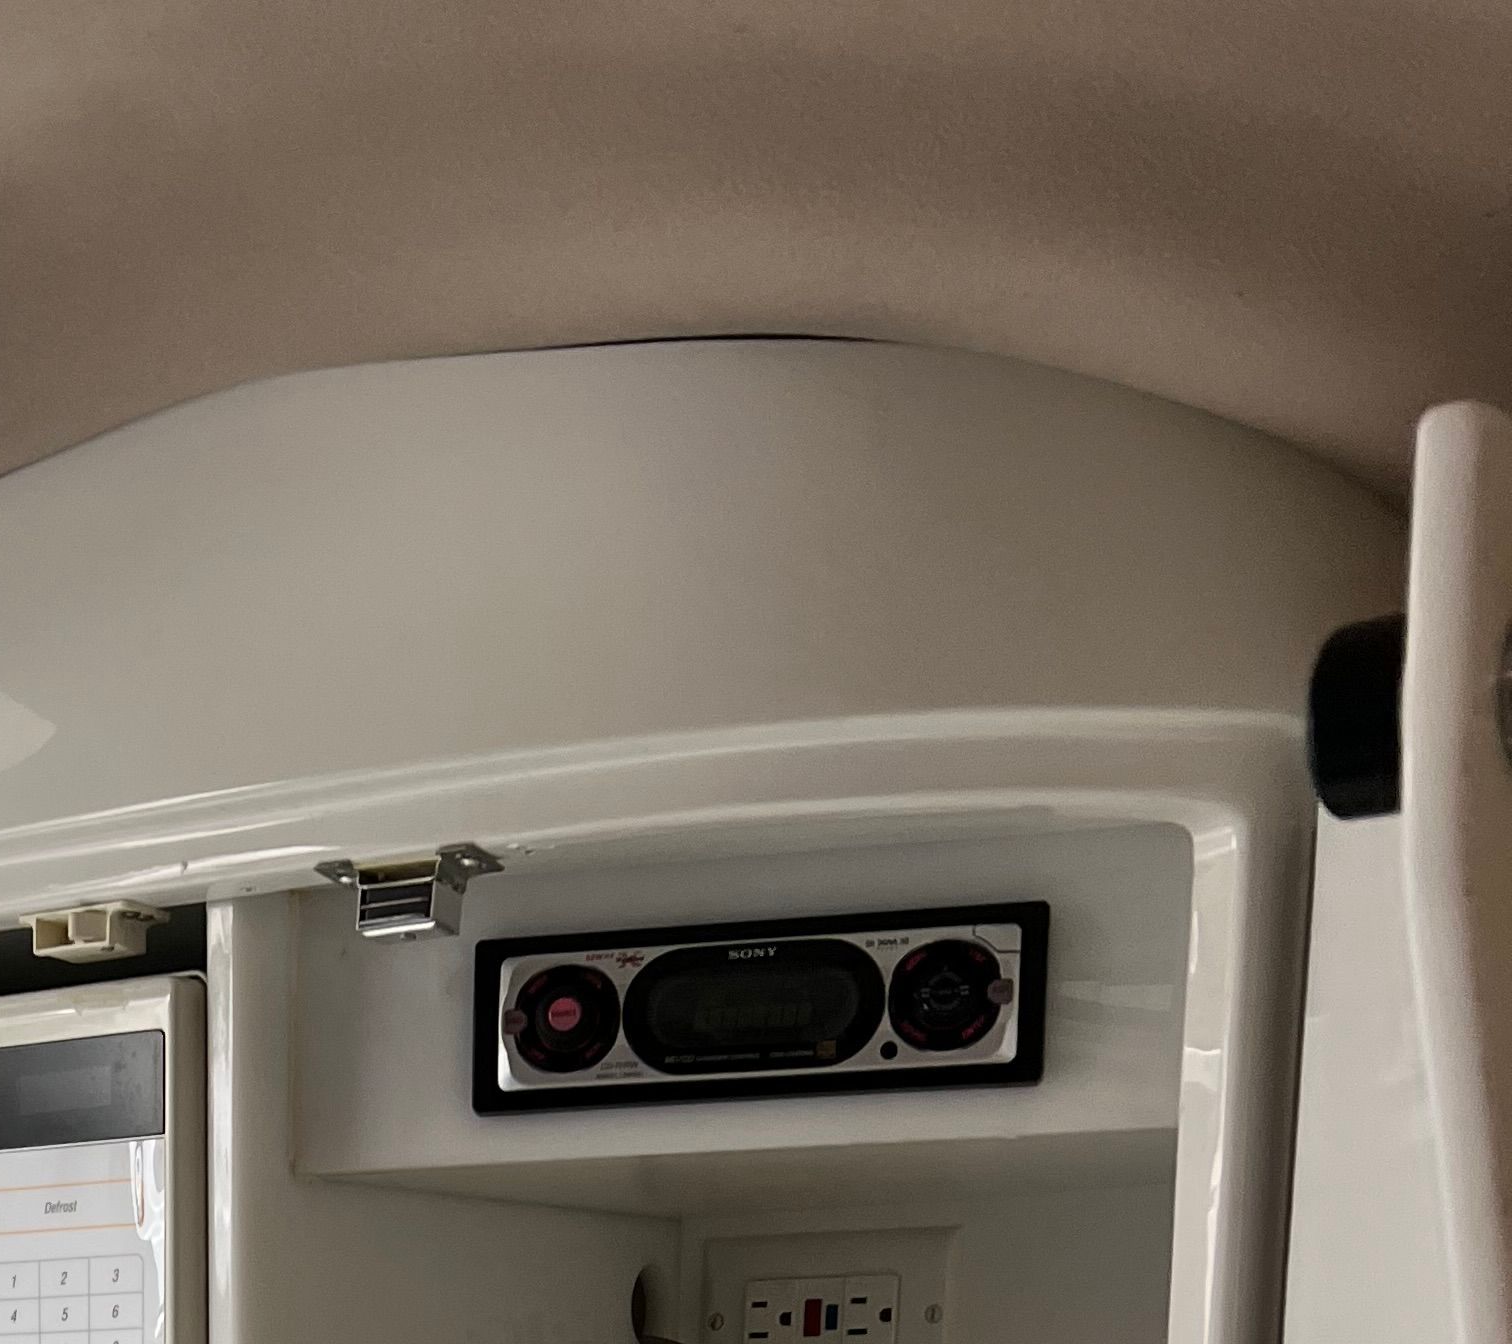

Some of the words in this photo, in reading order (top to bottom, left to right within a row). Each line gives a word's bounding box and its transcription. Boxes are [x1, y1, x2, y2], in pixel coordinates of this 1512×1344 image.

[727, 946, 778, 961] SONY
[43, 1199, 78, 1215] Defrost
[60, 1271, 68, 1286] 2
[112, 1268, 120, 1283] 3
[10, 1309, 18, 1324] 4
[62, 1307, 69, 1322] 5
[112, 1304, 119, 1319] 6
